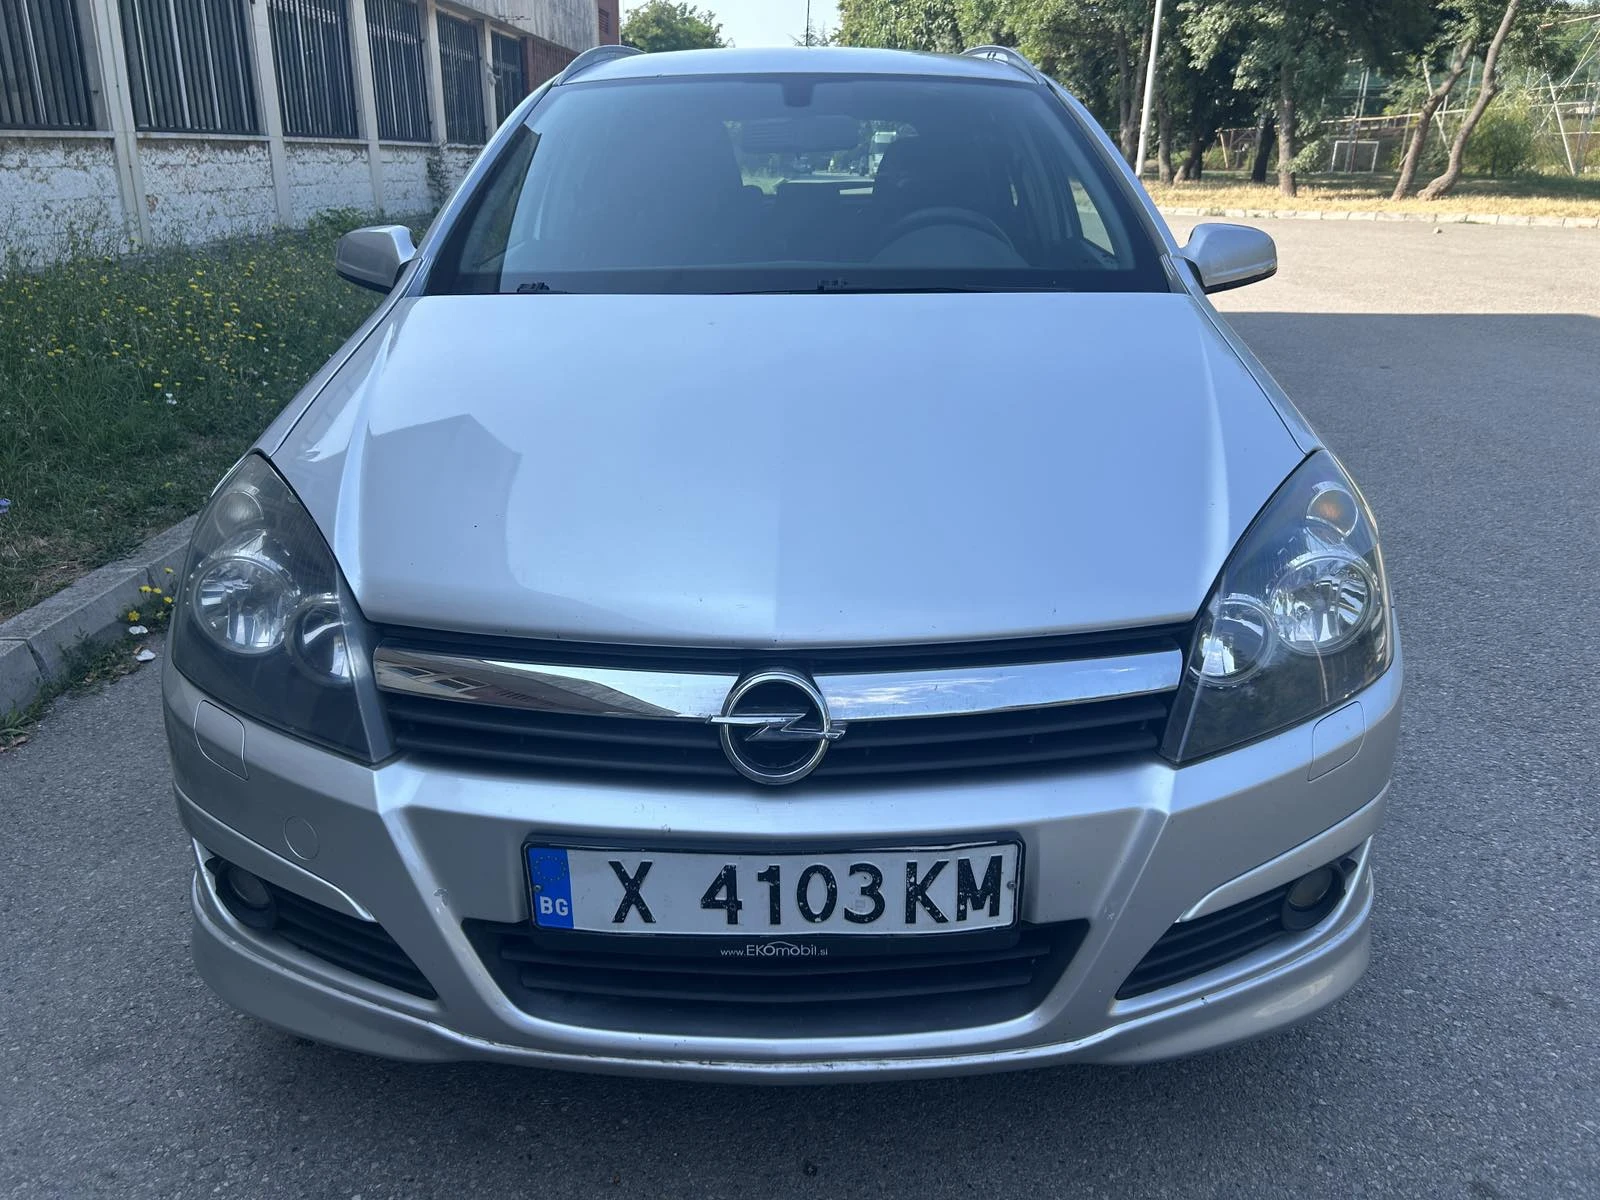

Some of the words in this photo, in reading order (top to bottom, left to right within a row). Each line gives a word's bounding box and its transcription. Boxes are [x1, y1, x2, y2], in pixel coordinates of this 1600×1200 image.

[539, 896, 569, 916] BG
[608, 860, 657, 924] X
[700, 864, 887, 926] 4103
[905, 855, 1004, 924] KM
